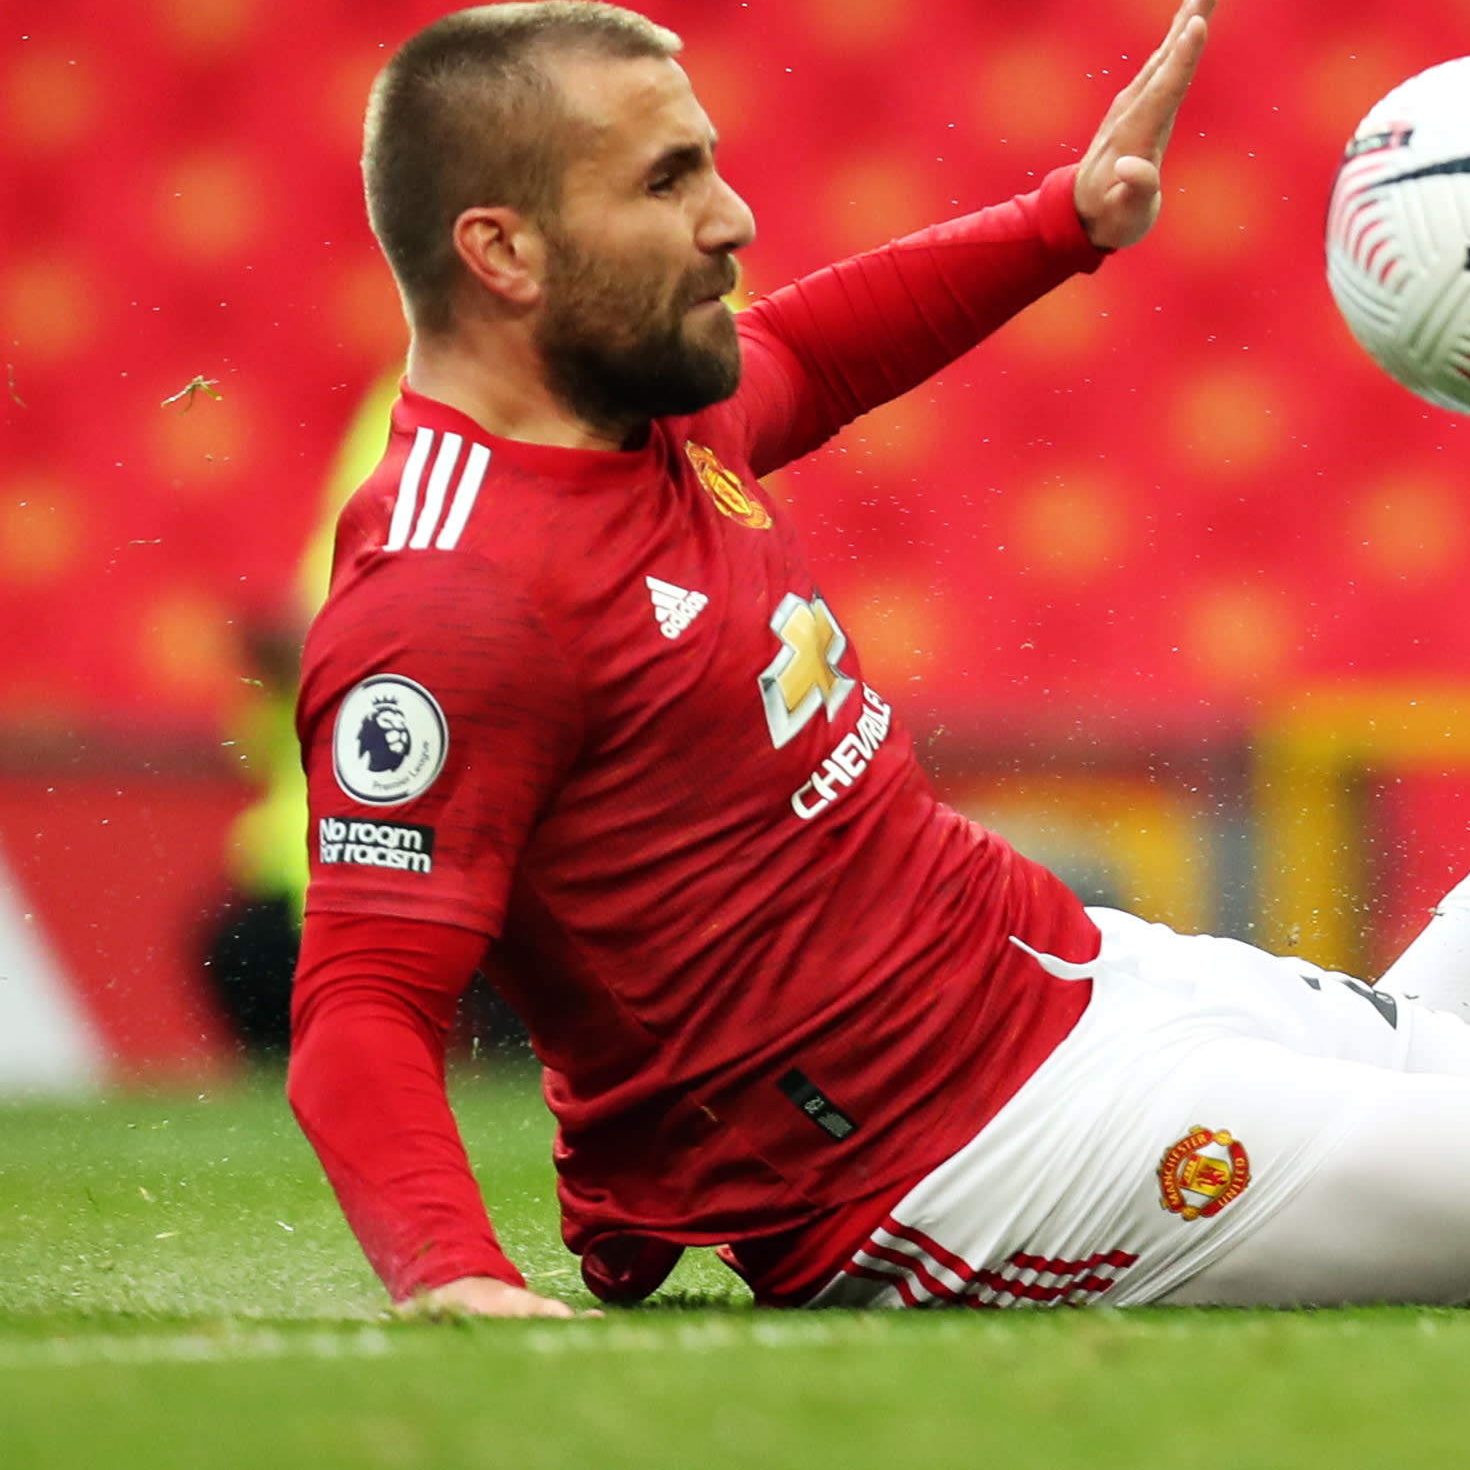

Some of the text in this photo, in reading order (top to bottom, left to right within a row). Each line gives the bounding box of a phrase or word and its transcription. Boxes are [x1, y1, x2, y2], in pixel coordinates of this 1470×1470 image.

[660, 590, 709, 640] adidas
[791, 681, 891, 819] CHEVROLE
[320, 817, 423, 852] No room
[343, 843, 433, 875] racism
[1163, 1133, 1208, 1206] MANCHESTER
[1217, 1157, 1246, 1207] UNITED
